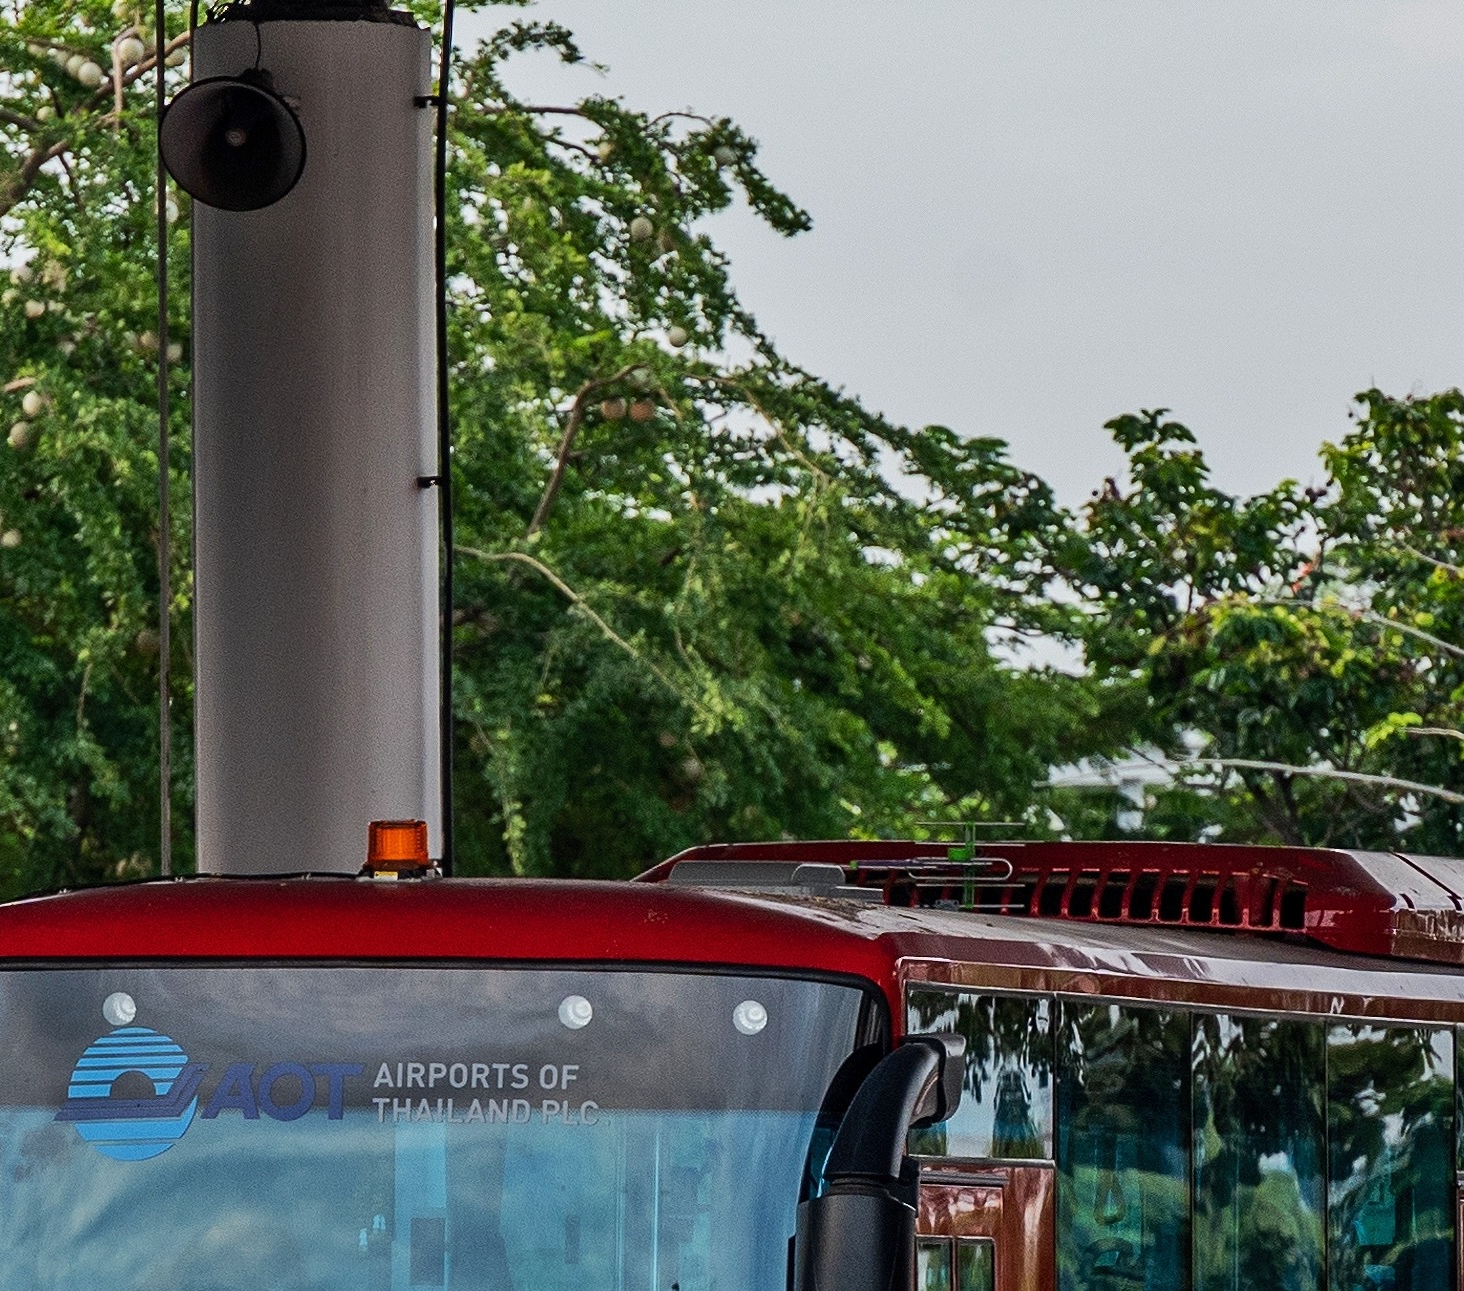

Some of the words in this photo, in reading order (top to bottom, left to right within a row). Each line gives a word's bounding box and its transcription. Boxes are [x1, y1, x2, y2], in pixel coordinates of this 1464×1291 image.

[200, 1061, 366, 1122] AOT
[373, 1061, 530, 1090] AIRPORTS
[538, 1063, 580, 1091] OF
[372, 1098, 531, 1125] THAILAND
